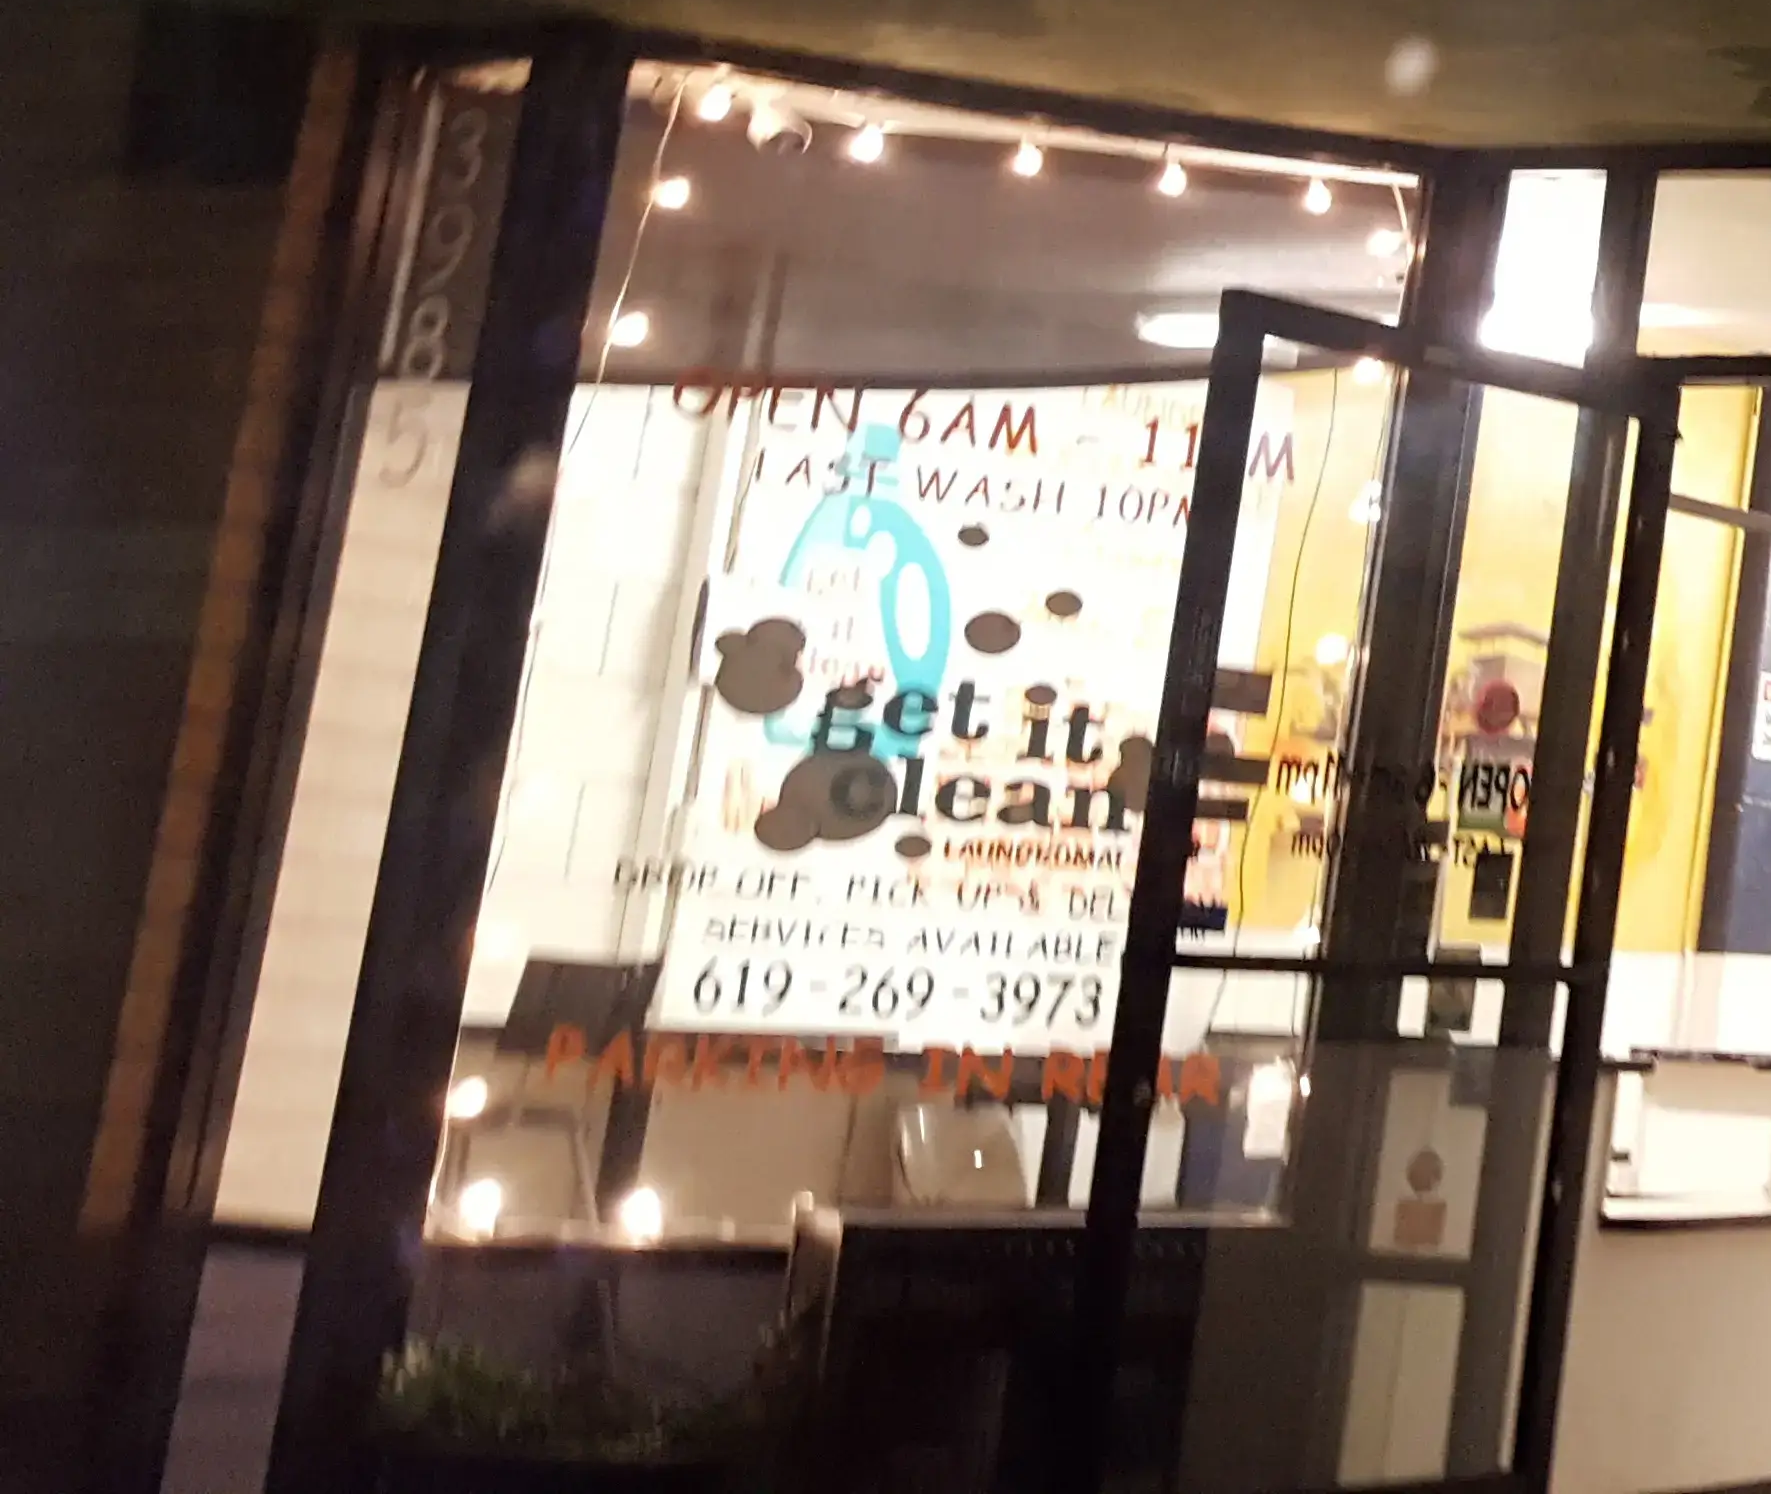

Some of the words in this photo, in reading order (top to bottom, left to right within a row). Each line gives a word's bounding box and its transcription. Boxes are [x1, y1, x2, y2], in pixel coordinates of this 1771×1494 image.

[673, 367, 866, 434] OPEN
[899, 387, 1040, 457] 6AM
[1140, 414, 1297, 484] 11M
[916, 465, 1066, 517] WASH
[812, 680, 990, 756] get
[1015, 684, 1104, 764] it
[829, 756, 1132, 832] clean
[544, 1024, 885, 1096] PARKING
[922, 1043, 1013, 1099] IN
